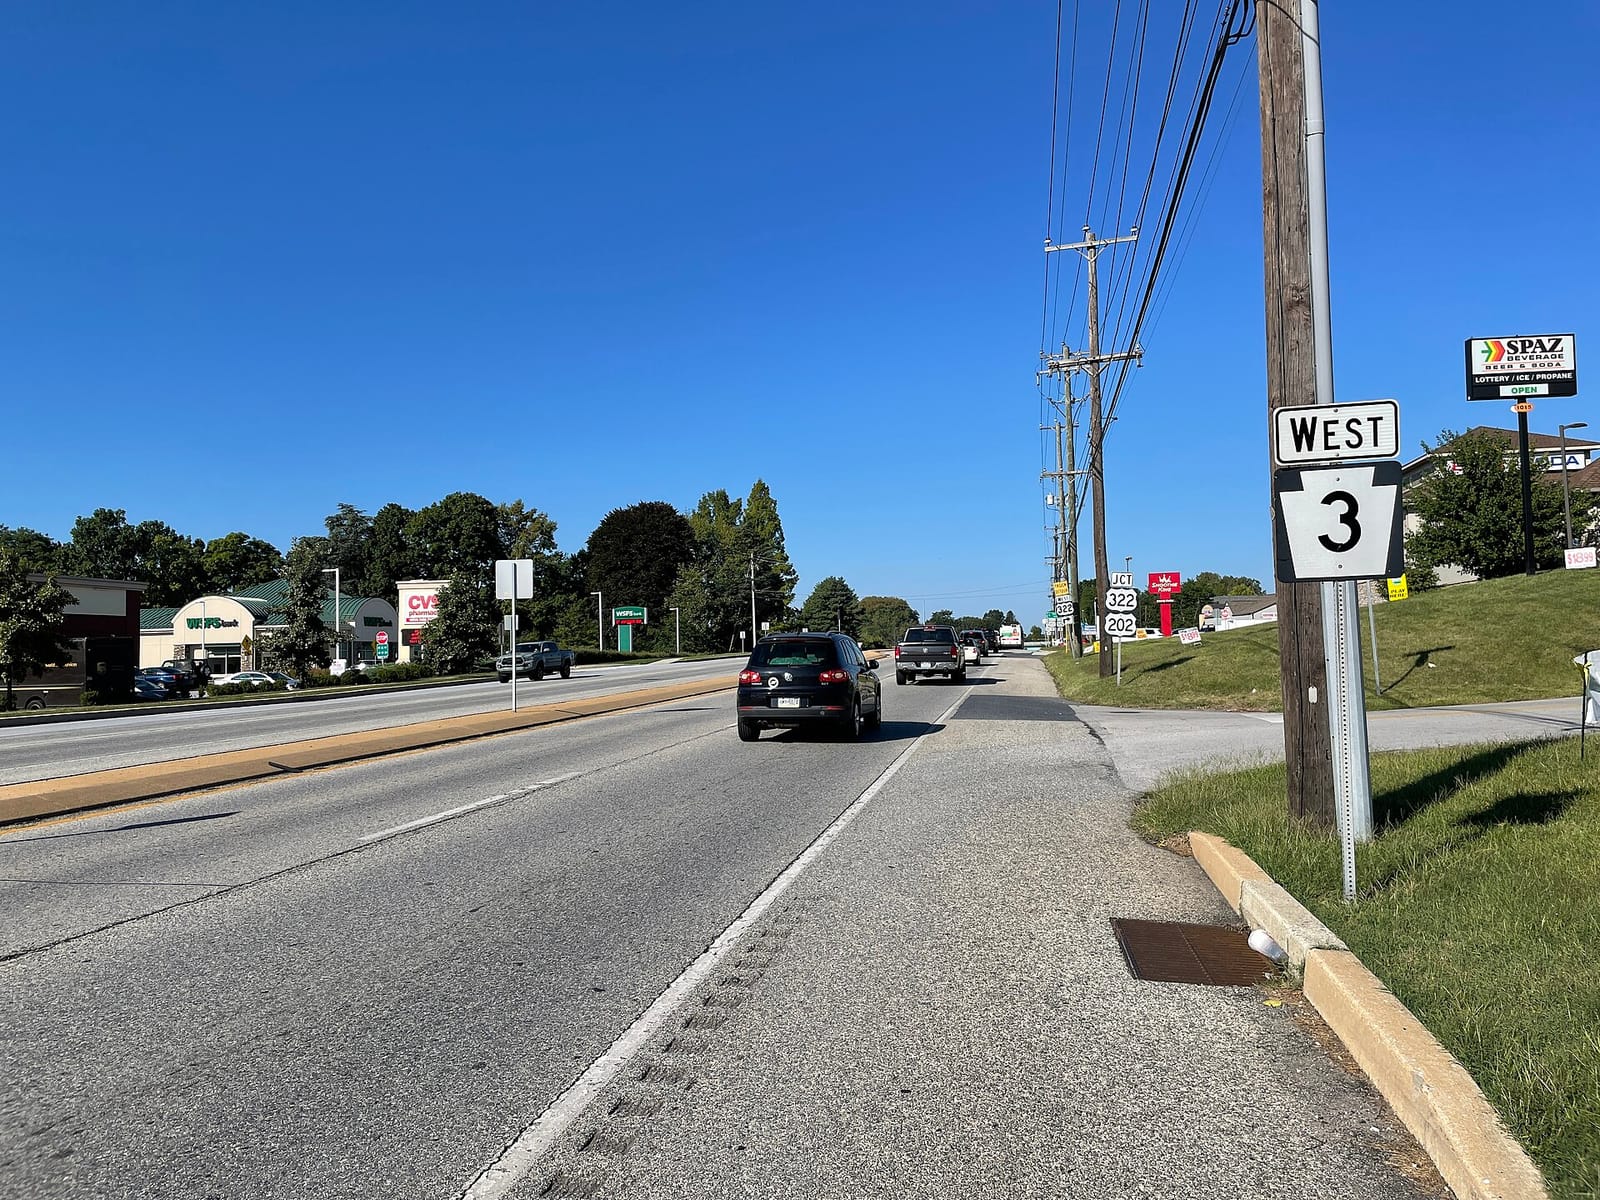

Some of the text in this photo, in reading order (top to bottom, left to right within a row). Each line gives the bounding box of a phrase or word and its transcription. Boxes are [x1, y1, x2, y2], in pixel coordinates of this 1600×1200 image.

[1506, 338, 1564, 355] SPAZ
[1507, 353, 1564, 361] BEVERAGE
[1475, 375, 1510, 383] LOTTERY
[1536, 372, 1573, 380] PROPANE
[1511, 386, 1537, 394] OPEN
[1289, 416, 1384, 453] WEST
[1317, 490, 1362, 553] 3
[1112, 574, 1132, 585] JCT
[1109, 593, 1135, 607] 322
[1057, 603, 1072, 614] 322
[1108, 618, 1133, 632] 202
